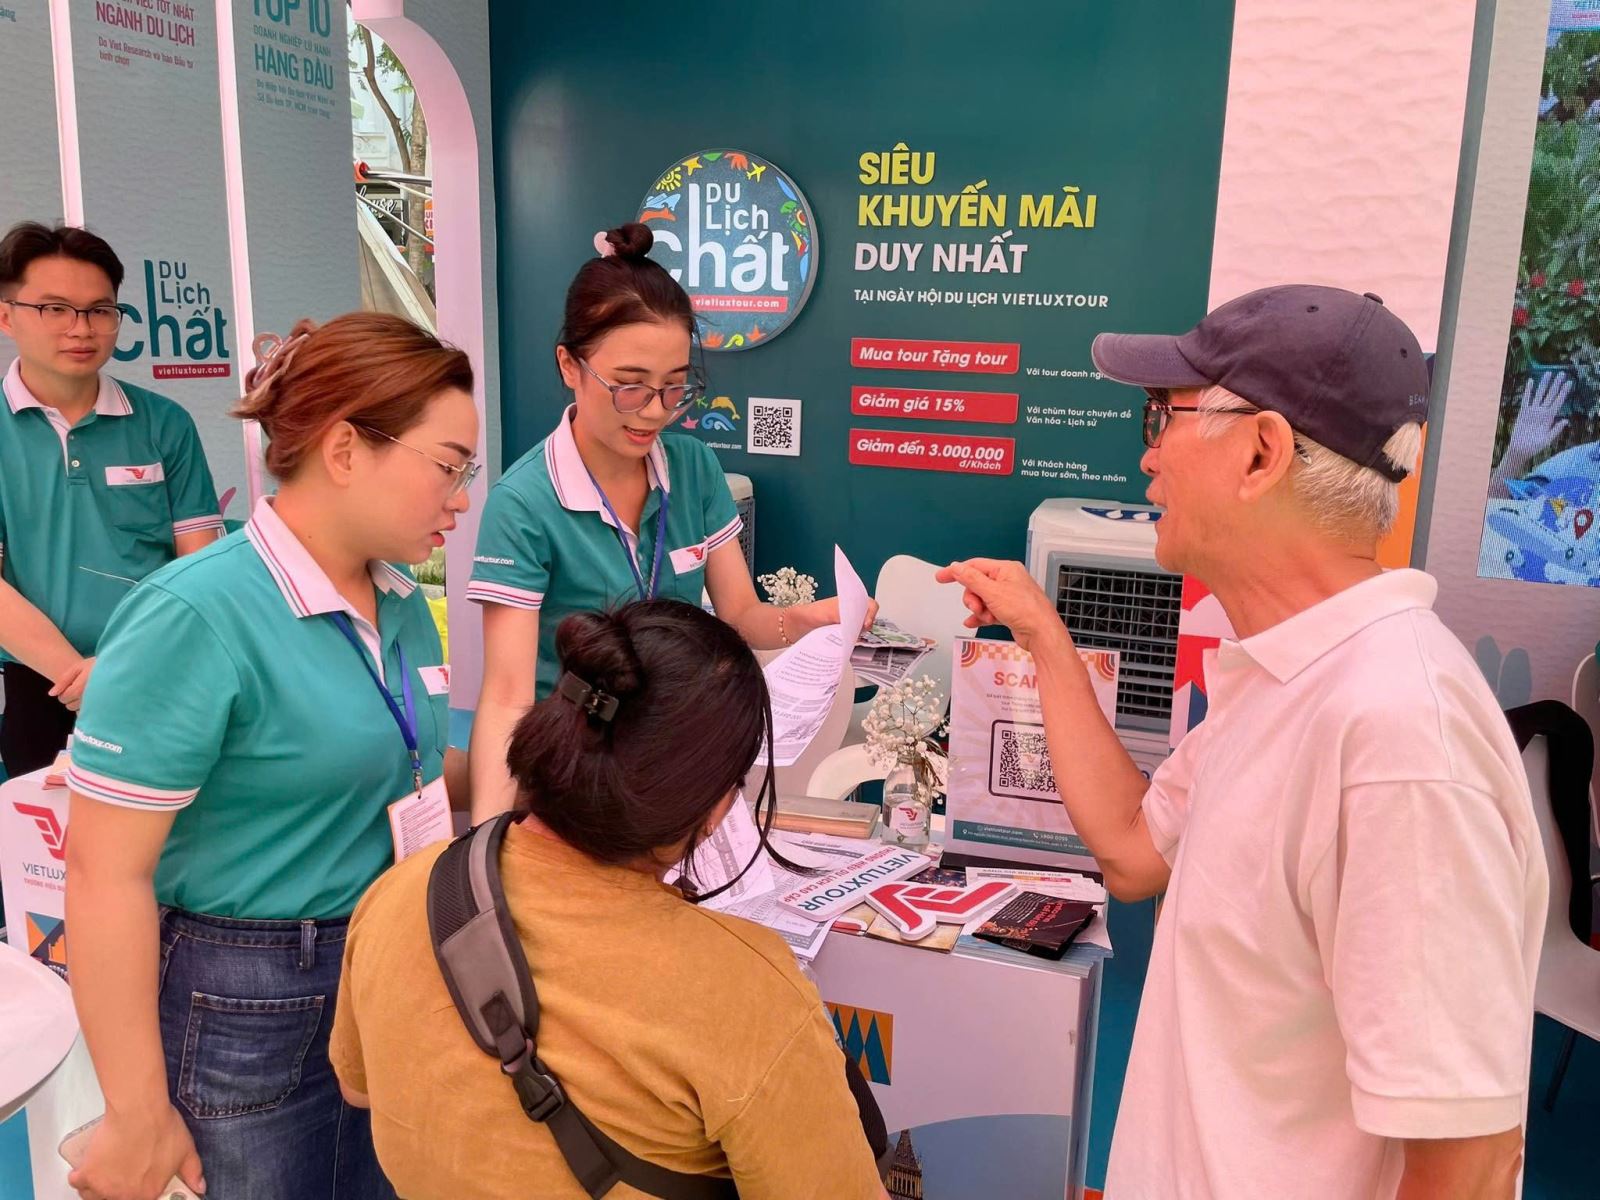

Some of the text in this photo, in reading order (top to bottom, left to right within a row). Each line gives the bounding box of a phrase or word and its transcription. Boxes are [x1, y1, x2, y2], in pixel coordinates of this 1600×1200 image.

[96, 1, 195, 47] NGÀNH DU LỊCH
[308, 0, 331, 38] 10
[254, 43, 300, 81] HÀNG
[858, 142, 936, 185] SIÊU
[706, 183, 740, 202] DU
[858, 179, 1097, 228] KHUYẾN MÃI
[706, 204, 769, 236] Lịch
[854, 229, 1028, 273] DUY NHẤT
[159, 261, 187, 279] DU
[160, 280, 210, 309] Lịch
[695, 297, 779, 308] vietluxtour.com
[854, 287, 1109, 308] TẠI NGÀY HỘI DU LỊCH VIETLUXTOUR
[859, 347, 1008, 367] Mua tour Tặng tour
[159, 366, 225, 375] vietluxtour.com
[1026, 368, 1040, 376] Với
[1042, 369, 1059, 377] tour
[1061, 369, 1088, 378] doanh
[859, 392, 966, 413] Giảm giá 15%
[1027, 406, 1040, 414] Với
[1068, 408, 1085, 416] tour
[1087, 409, 1118, 419] chuyên
[1044, 416, 1061, 424] hóa
[1067, 418, 1085, 427] Lịch
[856, 438, 1005, 461] Giảm đến 3.000.000
[1021, 469, 1040, 477] mua
[1041, 470, 1058, 478] tour
[1082, 472, 1101, 480] theo
[1102, 473, 1127, 482] nhóm
[1022, 459, 1088, 471] Với Khách hàng
[22, 862, 67, 880] VIETLUX
[798, 853, 920, 911] VIETLUXTOUR
